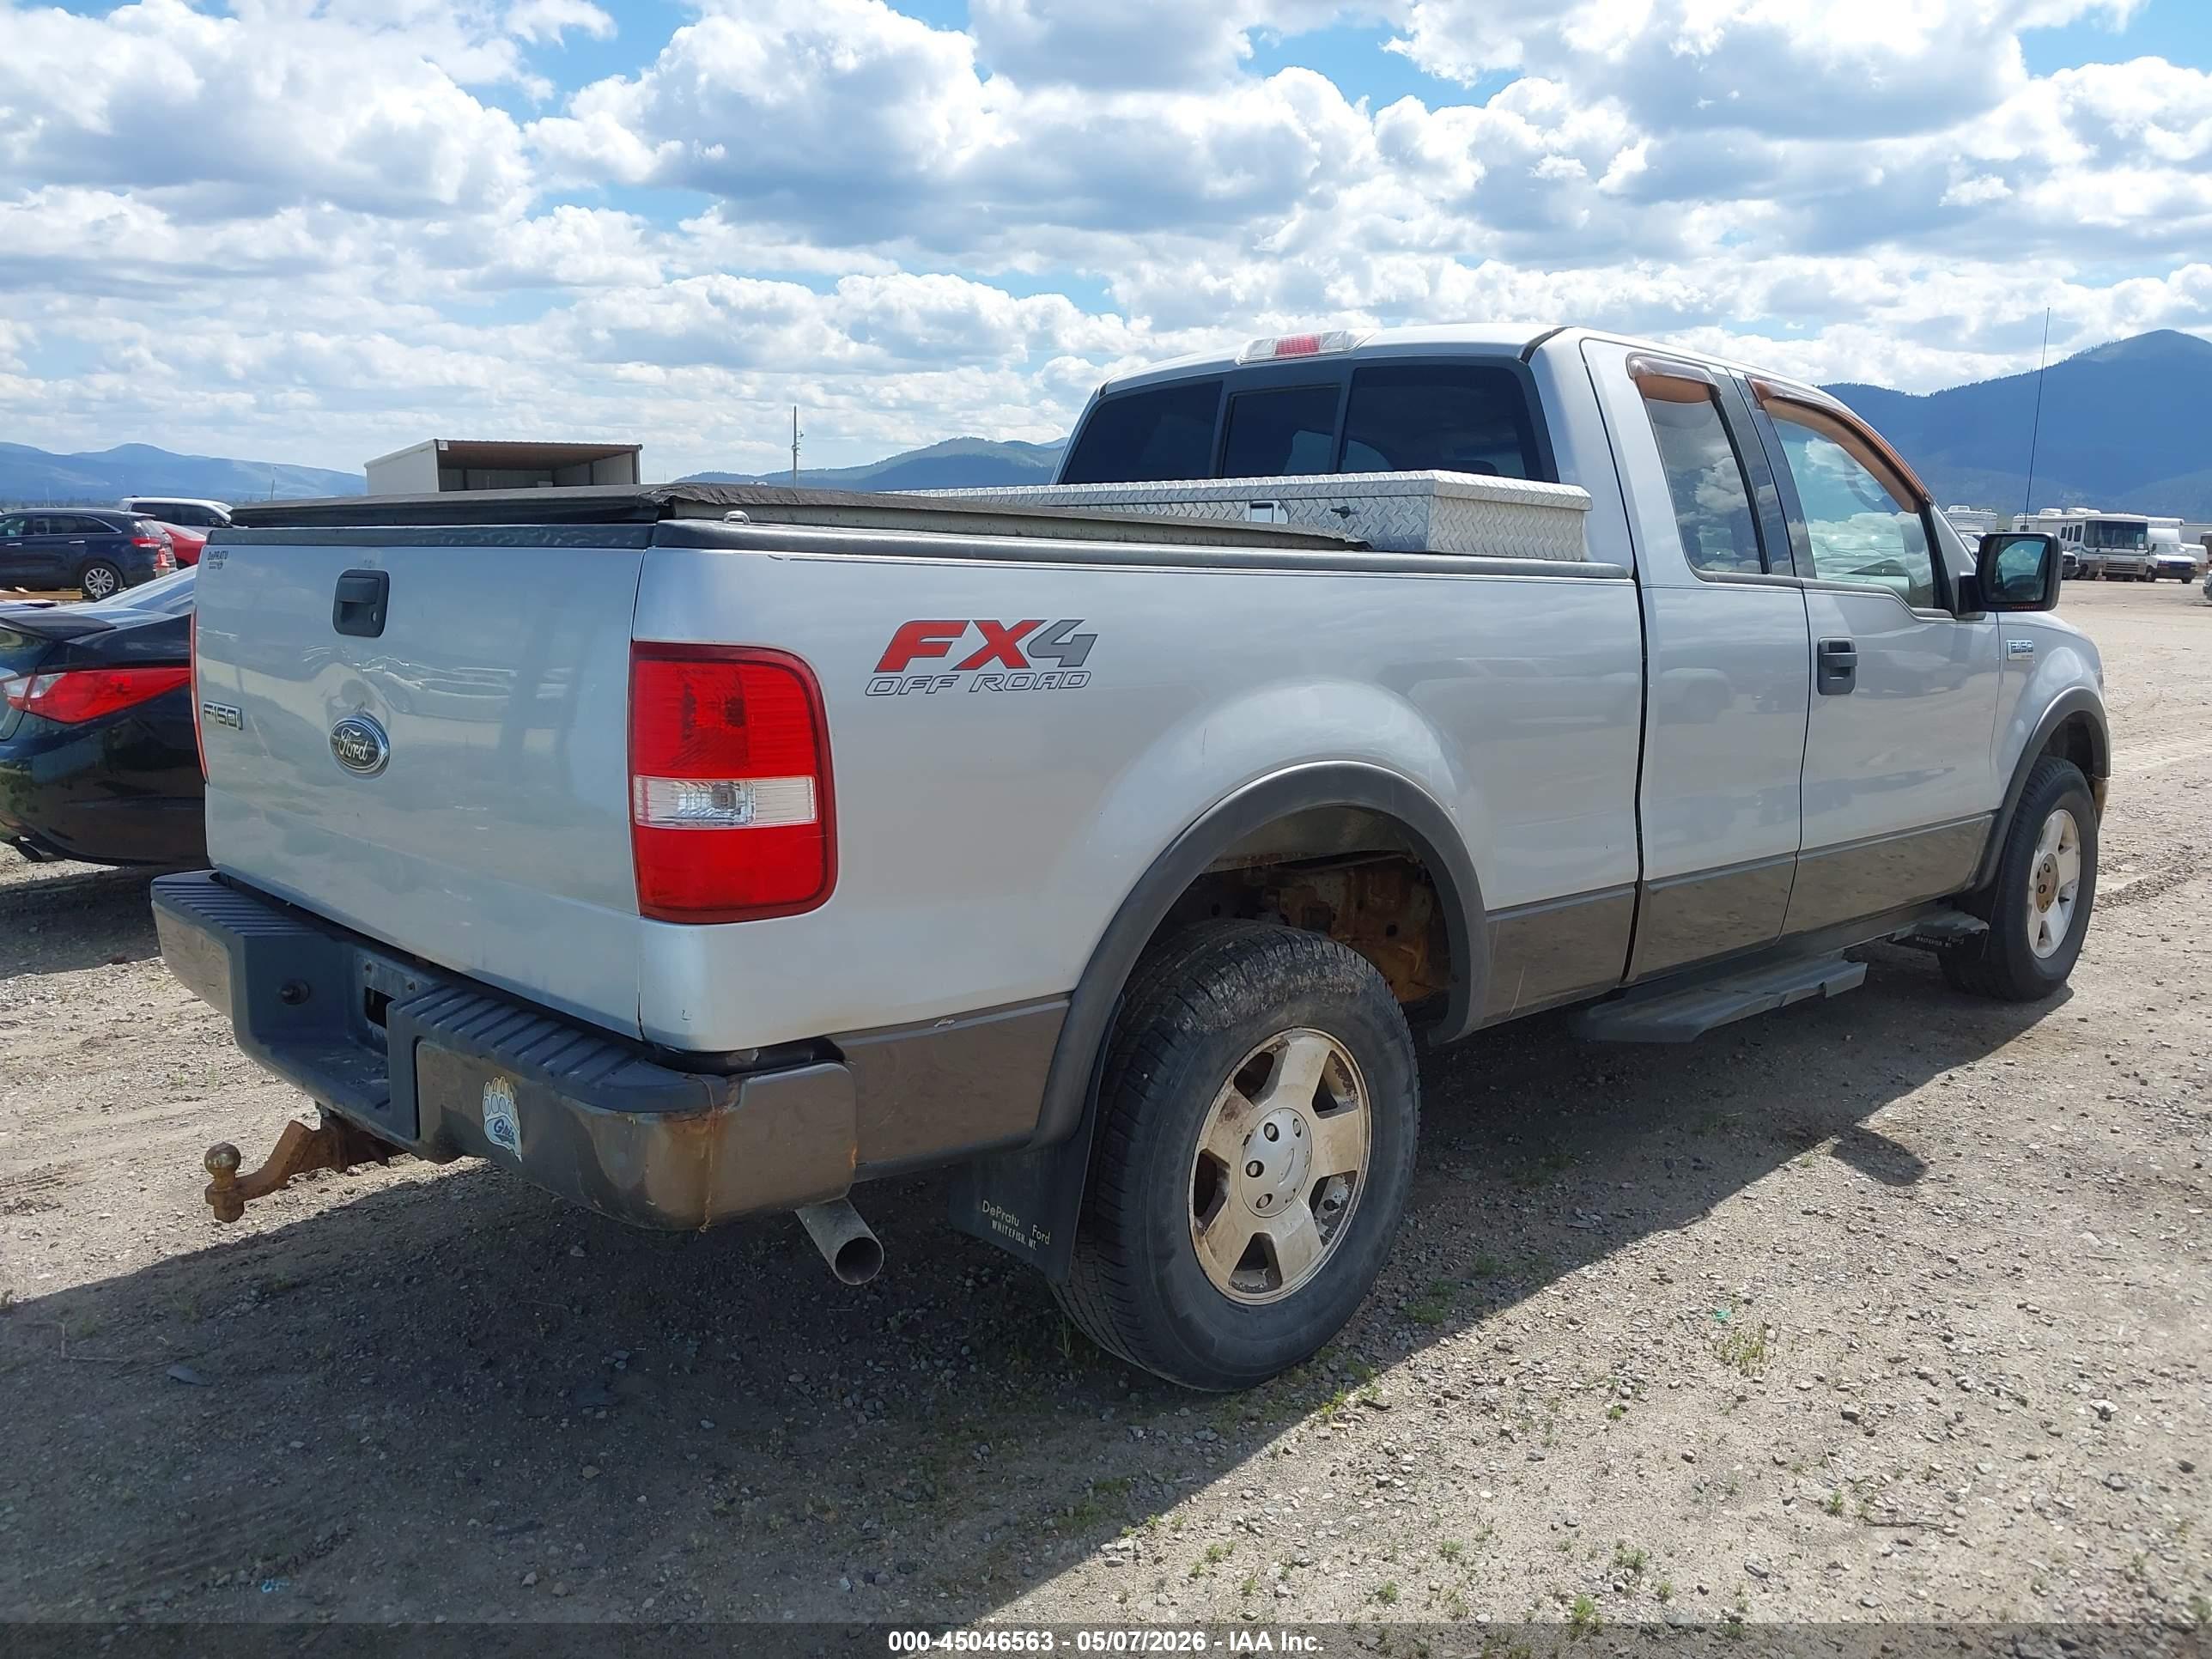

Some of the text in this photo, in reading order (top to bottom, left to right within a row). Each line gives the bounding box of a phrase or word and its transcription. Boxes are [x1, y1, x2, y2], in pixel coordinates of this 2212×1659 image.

[873, 619, 1098, 673] FX4
[865, 671, 1091, 697] OFF ROAD
[338, 726, 368, 761] Ford
[981, 1200, 1051, 1245] DePratu Ford
